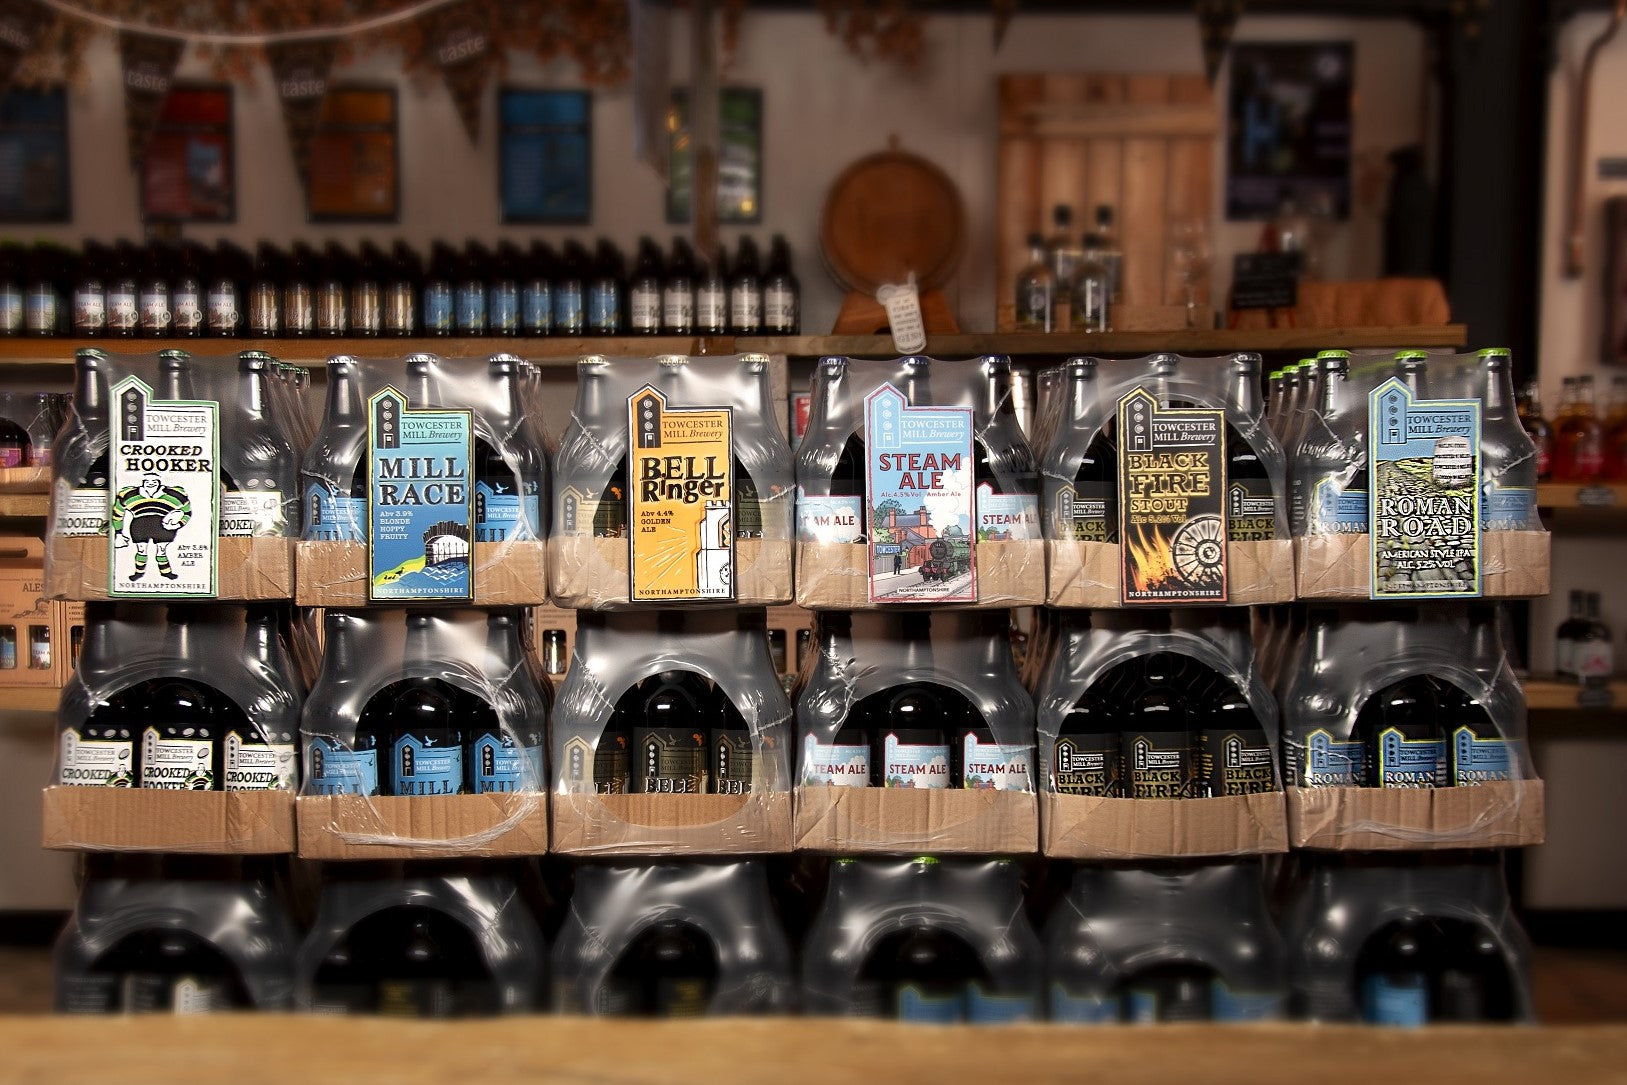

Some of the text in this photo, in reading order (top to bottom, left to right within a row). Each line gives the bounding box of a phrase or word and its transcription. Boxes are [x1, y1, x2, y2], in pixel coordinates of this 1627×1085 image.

[439, 36, 486, 64] taste
[281, 80, 325, 97] taste
[146, 415, 207, 423] TOWCESTER
[662, 420, 723, 428] TOWCESTER
[901, 420, 965, 429] TOWCESTER
[1407, 415, 1471, 424] TOWCESTER
[148, 424, 207, 435] MILL Brewery
[401, 421, 462, 430] TOWCESTER
[1152, 422, 1216, 431] TOWCESTER
[1408, 425, 1471, 435] MILL Brewery
[403, 430, 462, 440] MILL Brewery
[664, 429, 723, 439] MILL Brewery
[903, 429, 965, 440] MILL Brewery
[1154, 431, 1216, 443] MILL Brewery
[120, 445, 203, 456] CROOKED
[126, 459, 213, 472] HOOKER
[879, 453, 961, 471] STEAM
[1128, 452, 1209, 471] BLACK
[379, 457, 464, 479] MILL
[640, 456, 725, 480] BELL
[899, 472, 944, 489] ALE
[1130, 472, 1210, 497] FIRE
[379, 483, 465, 506] RACE
[641, 478, 725, 504] Ringer
[1130, 498, 1188, 512] STOUT
[1380, 496, 1473, 516] ROMAN
[834, 515, 855, 526] ALE
[982, 514, 1021, 525] STEAM
[1131, 515, 1147, 524] Alc
[1228, 519, 1275, 530] BLACK
[1380, 517, 1473, 538] ROAD
[1381, 549, 1429, 559] AMERICAN
[1430, 549, 1454, 558] STYLE
[1438, 560, 1456, 568] VOL
[63, 768, 111, 779] CROOKED
[144, 766, 190, 778] CROOKED
[814, 764, 866, 775] TEAM ALE
[889, 764, 947, 775] STEAM ALE
[968, 763, 1027, 774] STEAM ALE
[1226, 768, 1272, 780] BLACK
[226, 771, 274, 783] CROOKED
[1058, 773, 1105, 785] BLACK
[1134, 771, 1180, 782] BLACK
[1385, 771, 1436, 783] ROMAN
[1458, 770, 1509, 781] ROMAN
[400, 780, 454, 796] MILL
[1134, 783, 1181, 798] FIRE
[1226, 780, 1273, 796] FIRE
